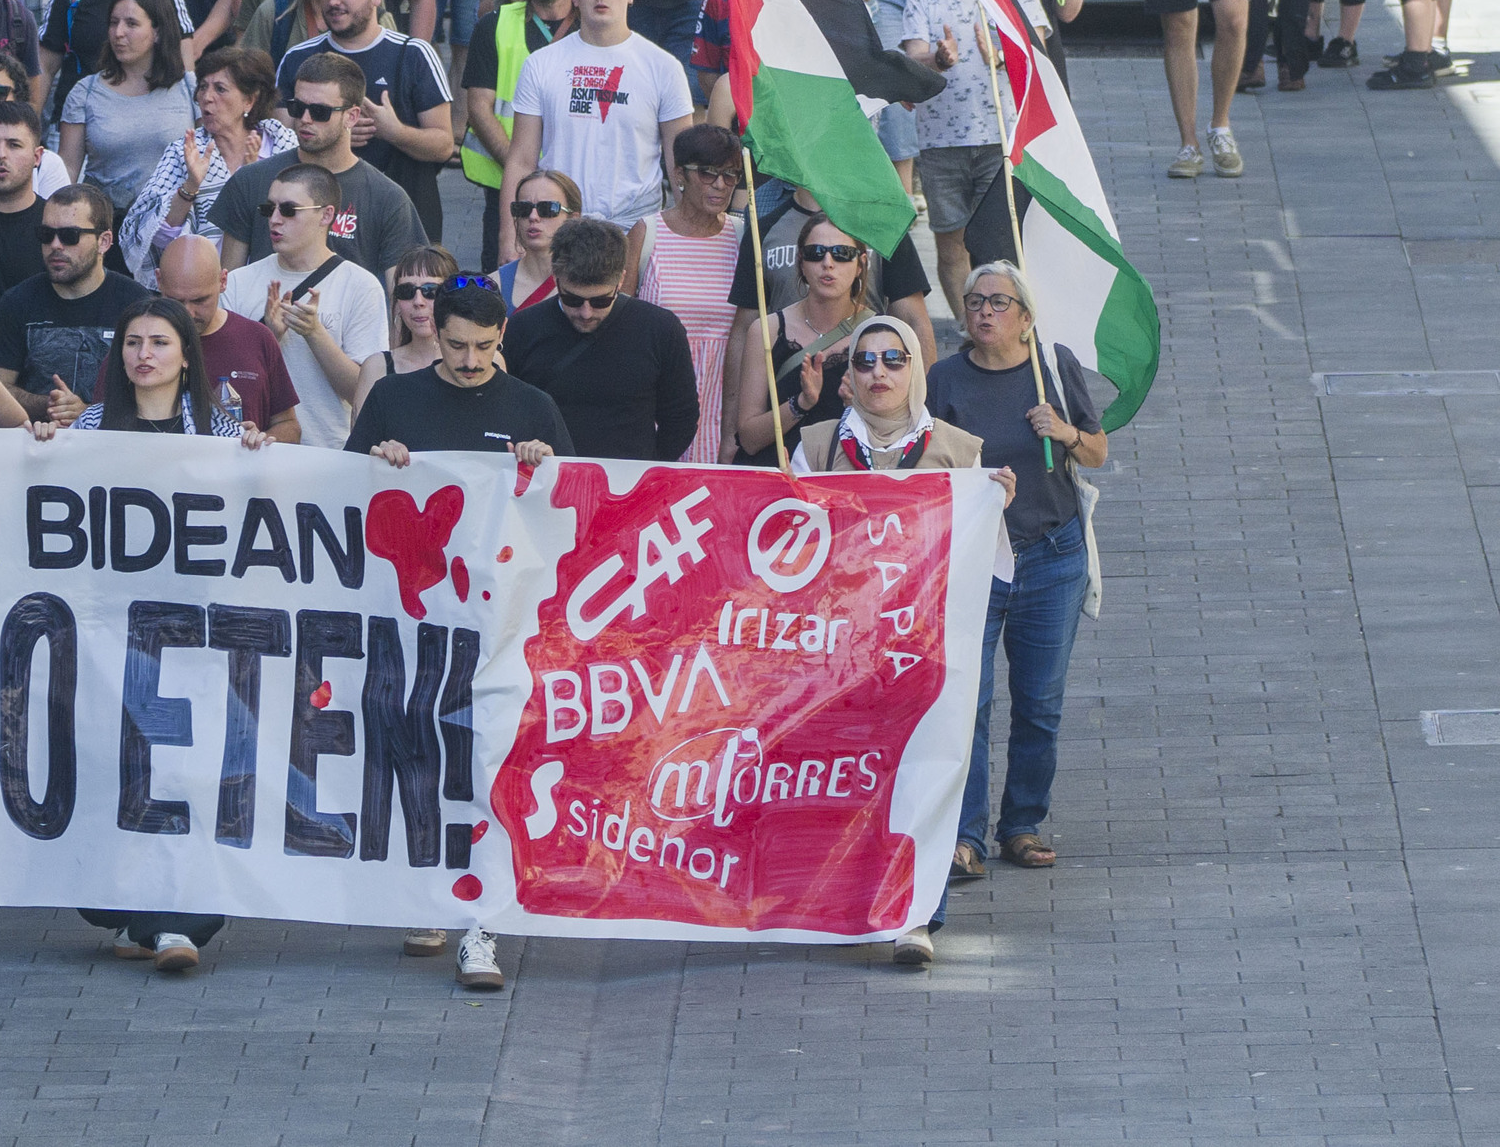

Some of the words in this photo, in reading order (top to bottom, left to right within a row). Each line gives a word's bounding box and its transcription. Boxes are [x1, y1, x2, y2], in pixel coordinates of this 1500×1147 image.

[569, 100, 592, 114] GABE
[570, 88, 629, 105] ASKATASUNIK
[572, 77, 582, 87] EZ
[583, 77, 605, 89] DAGO
[573, 65, 606, 77] BAKERIK
[26, 485, 366, 590] BIDEAN
[566, 486, 714, 642] CAF
[867, 513, 923, 680] SAPA
[116, 600, 480, 870] ETEN!
[541, 642, 731, 744] BBVA
